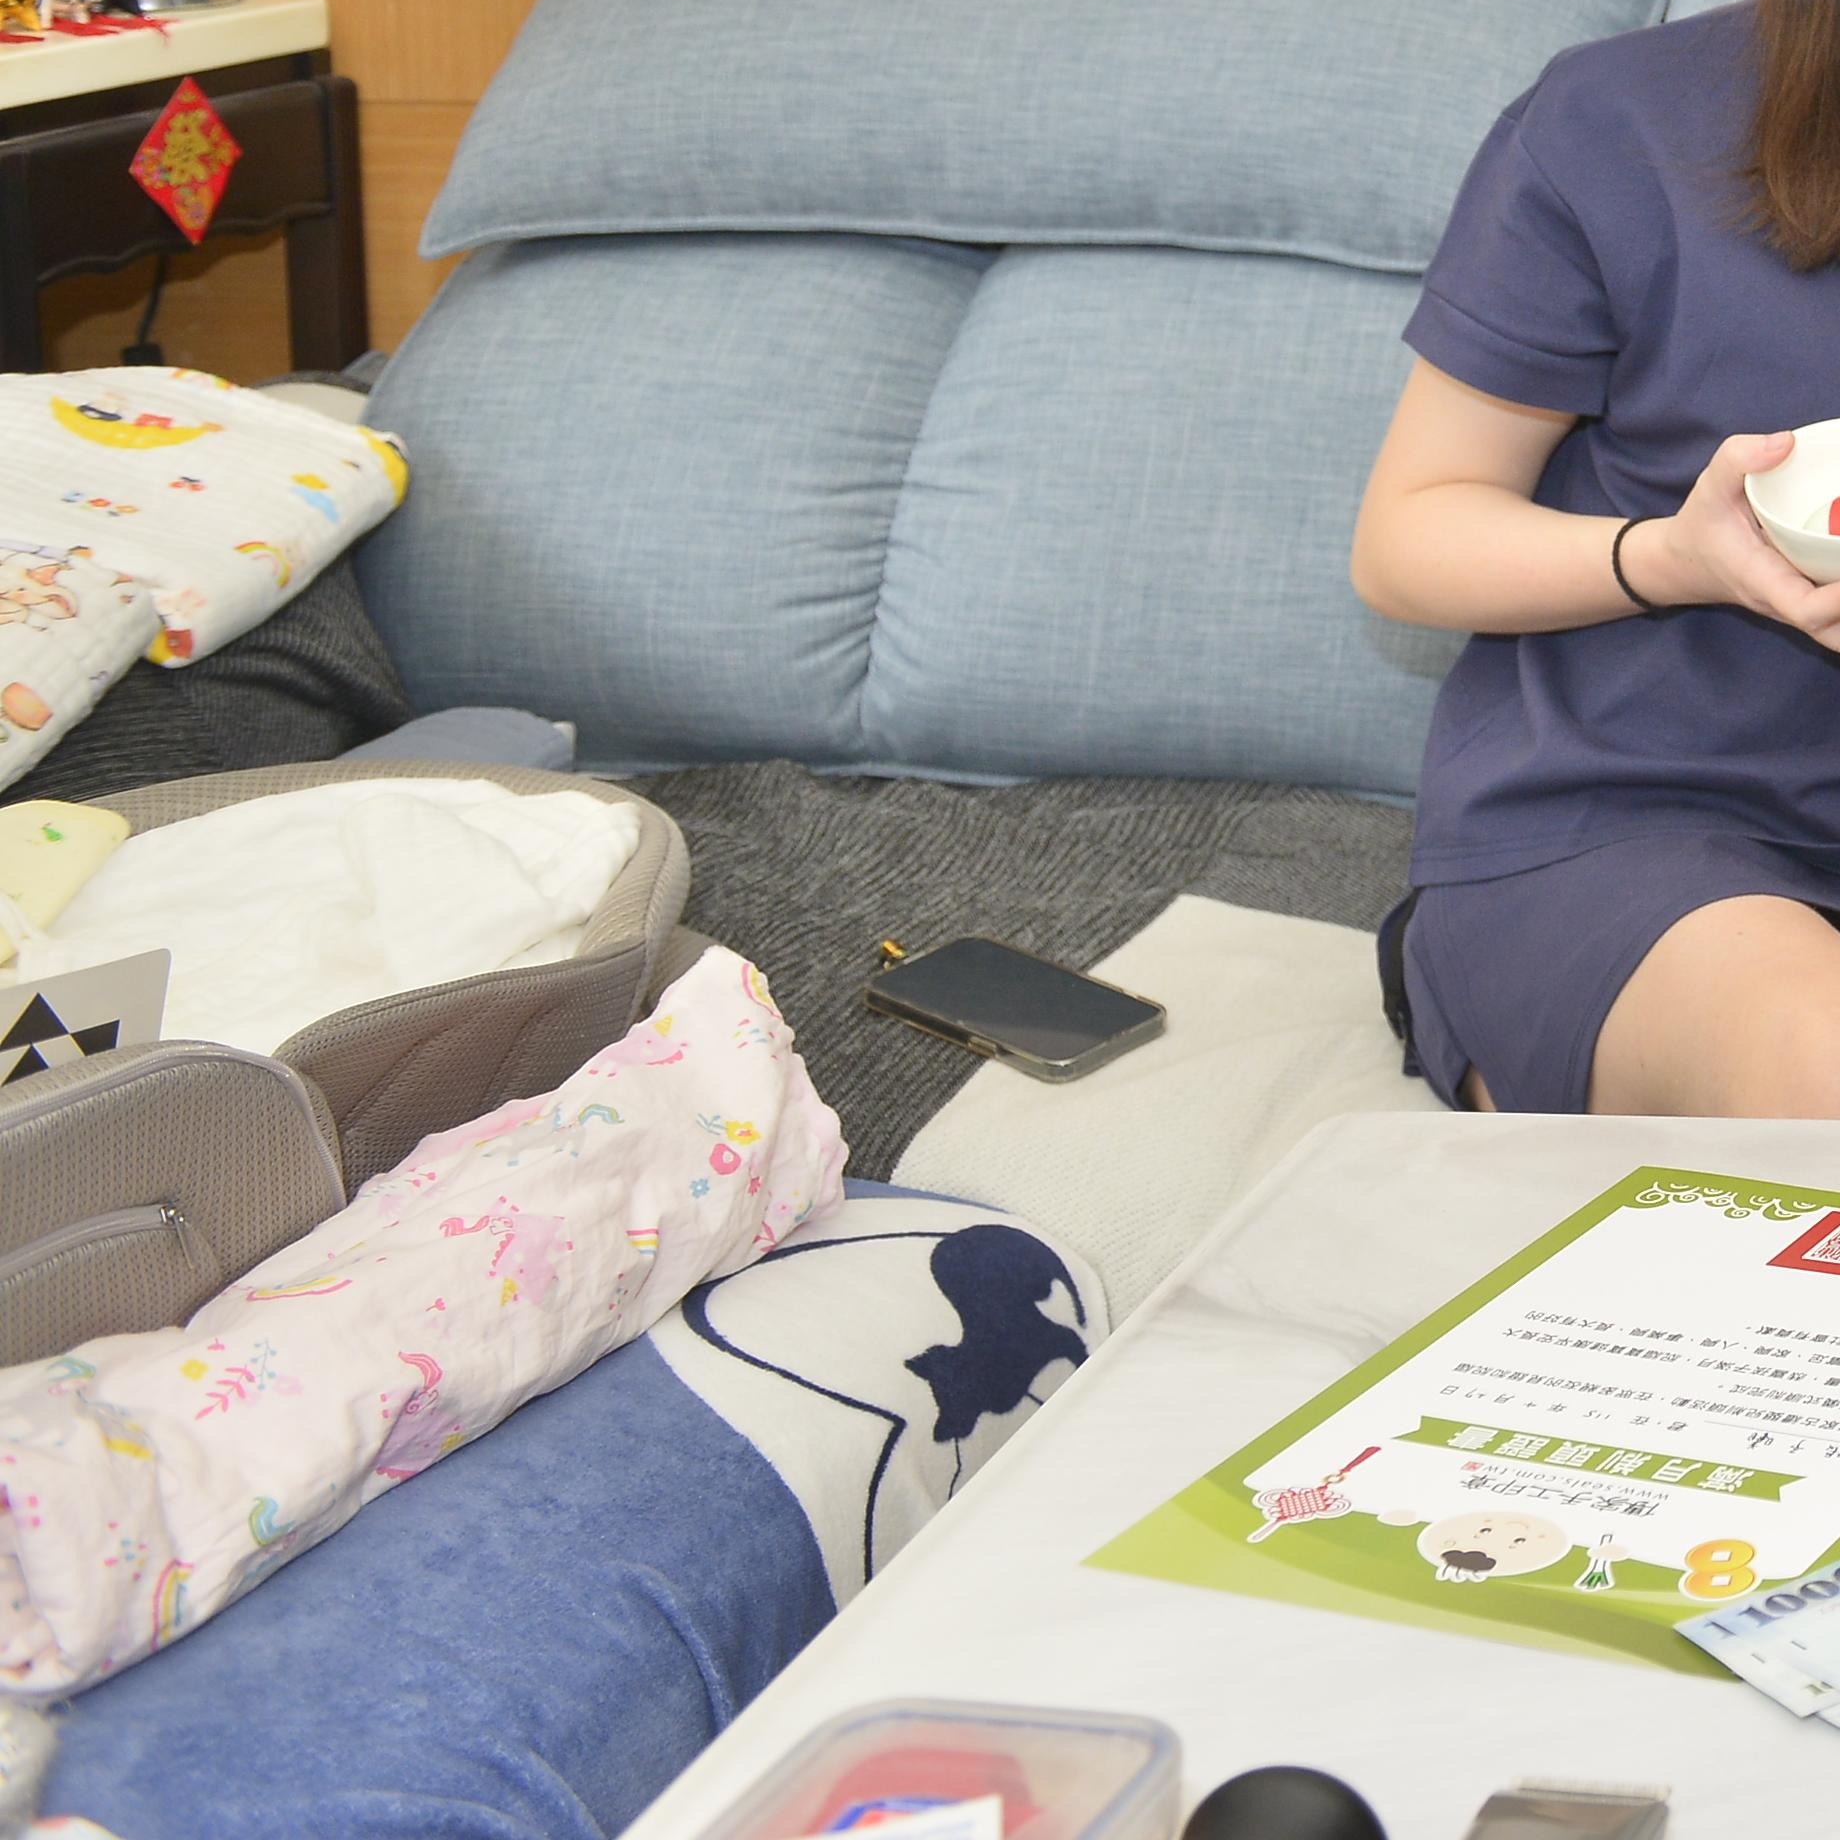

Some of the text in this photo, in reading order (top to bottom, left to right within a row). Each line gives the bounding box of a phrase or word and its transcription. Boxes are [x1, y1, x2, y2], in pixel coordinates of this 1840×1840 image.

[1447, 1426, 1754, 1492] 滿月剃頭證書
[1460, 1475, 1660, 1517] 傳家手工印章
[1483, 1465, 1669, 1500] www.seals.com.tw
